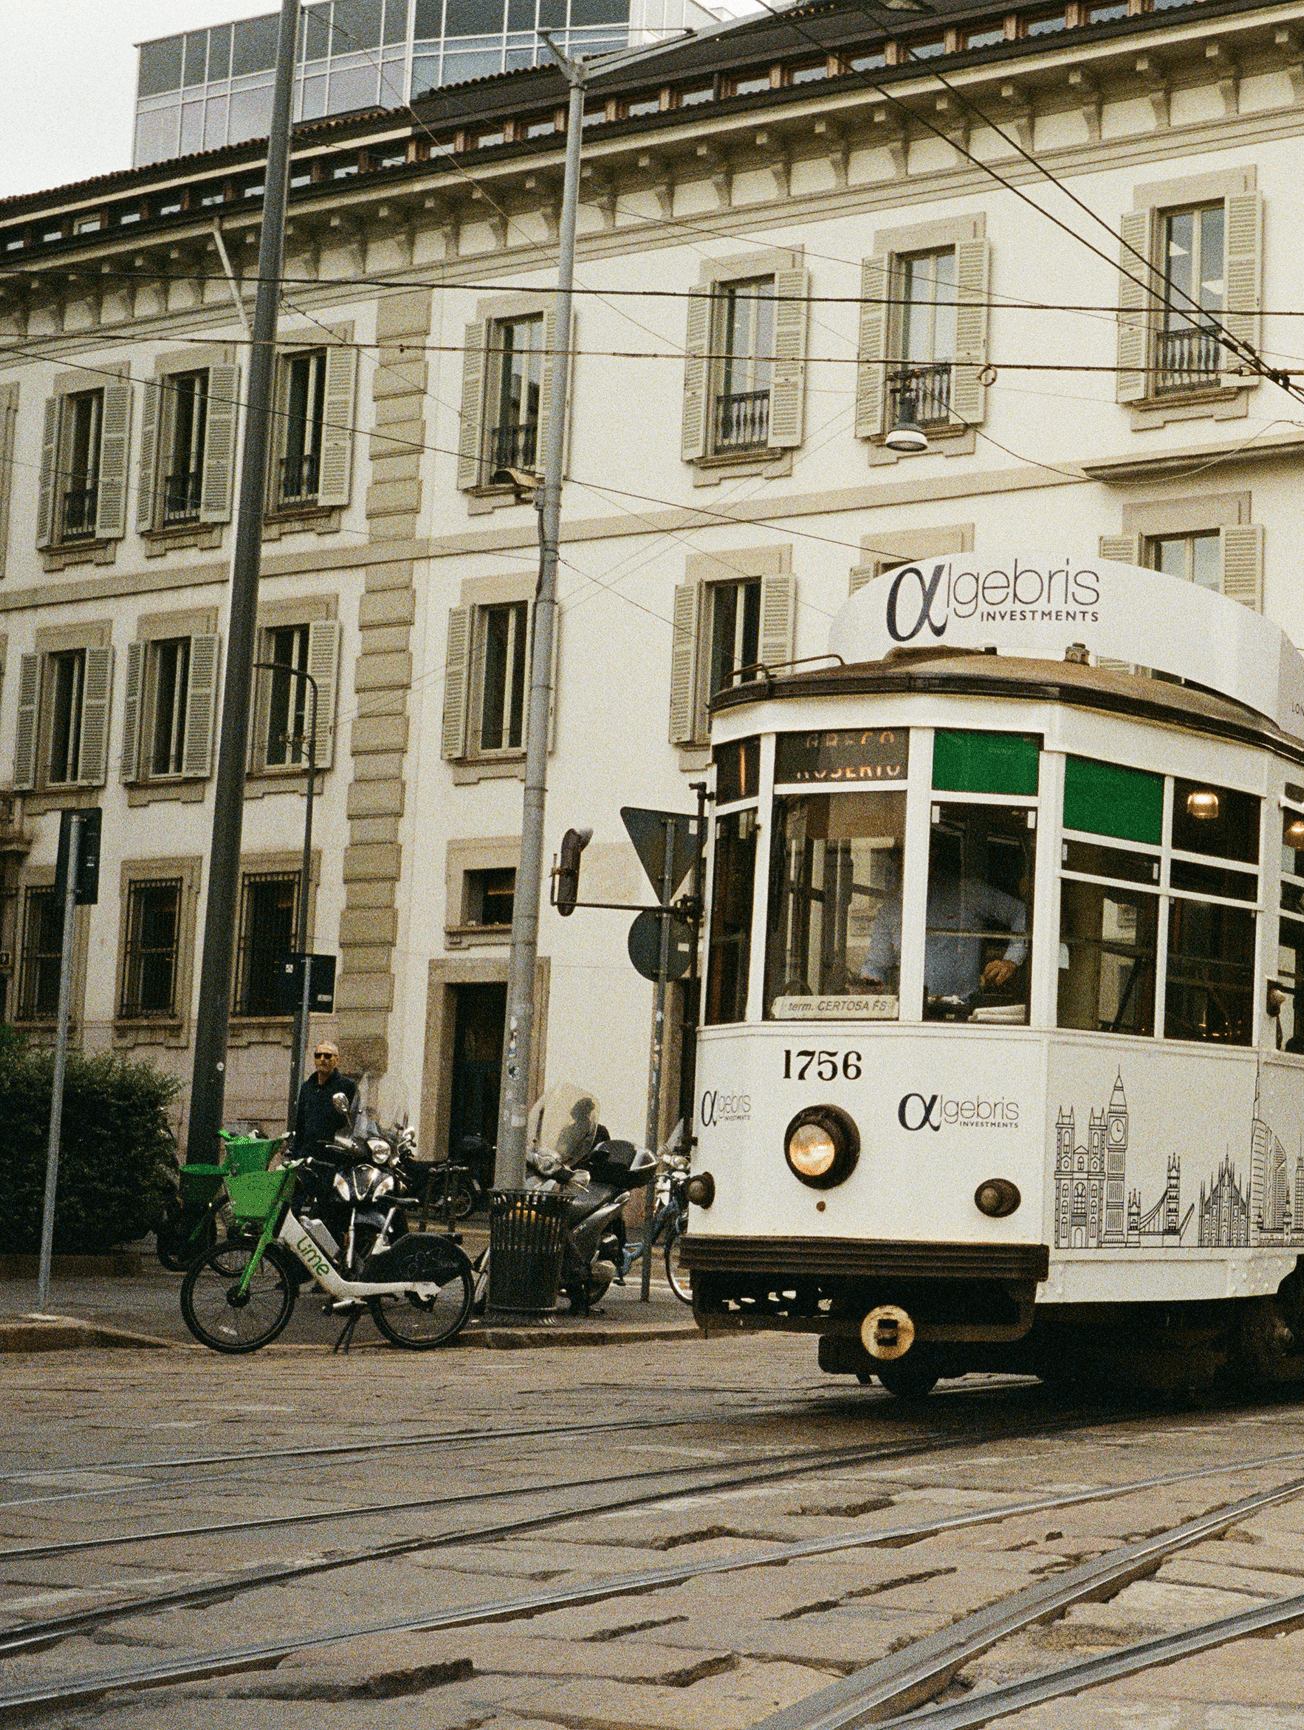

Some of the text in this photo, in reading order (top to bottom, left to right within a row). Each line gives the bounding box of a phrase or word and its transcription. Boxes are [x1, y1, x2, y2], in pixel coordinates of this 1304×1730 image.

[980, 610, 1099, 622] INVESTMENTS
[789, 1000, 887, 1011] term. CERTOSA FS
[783, 1049, 862, 1081] 1756
[960, 1121, 1019, 1129] INVESTMENTS
[297, 1236, 329, 1276] Lime
